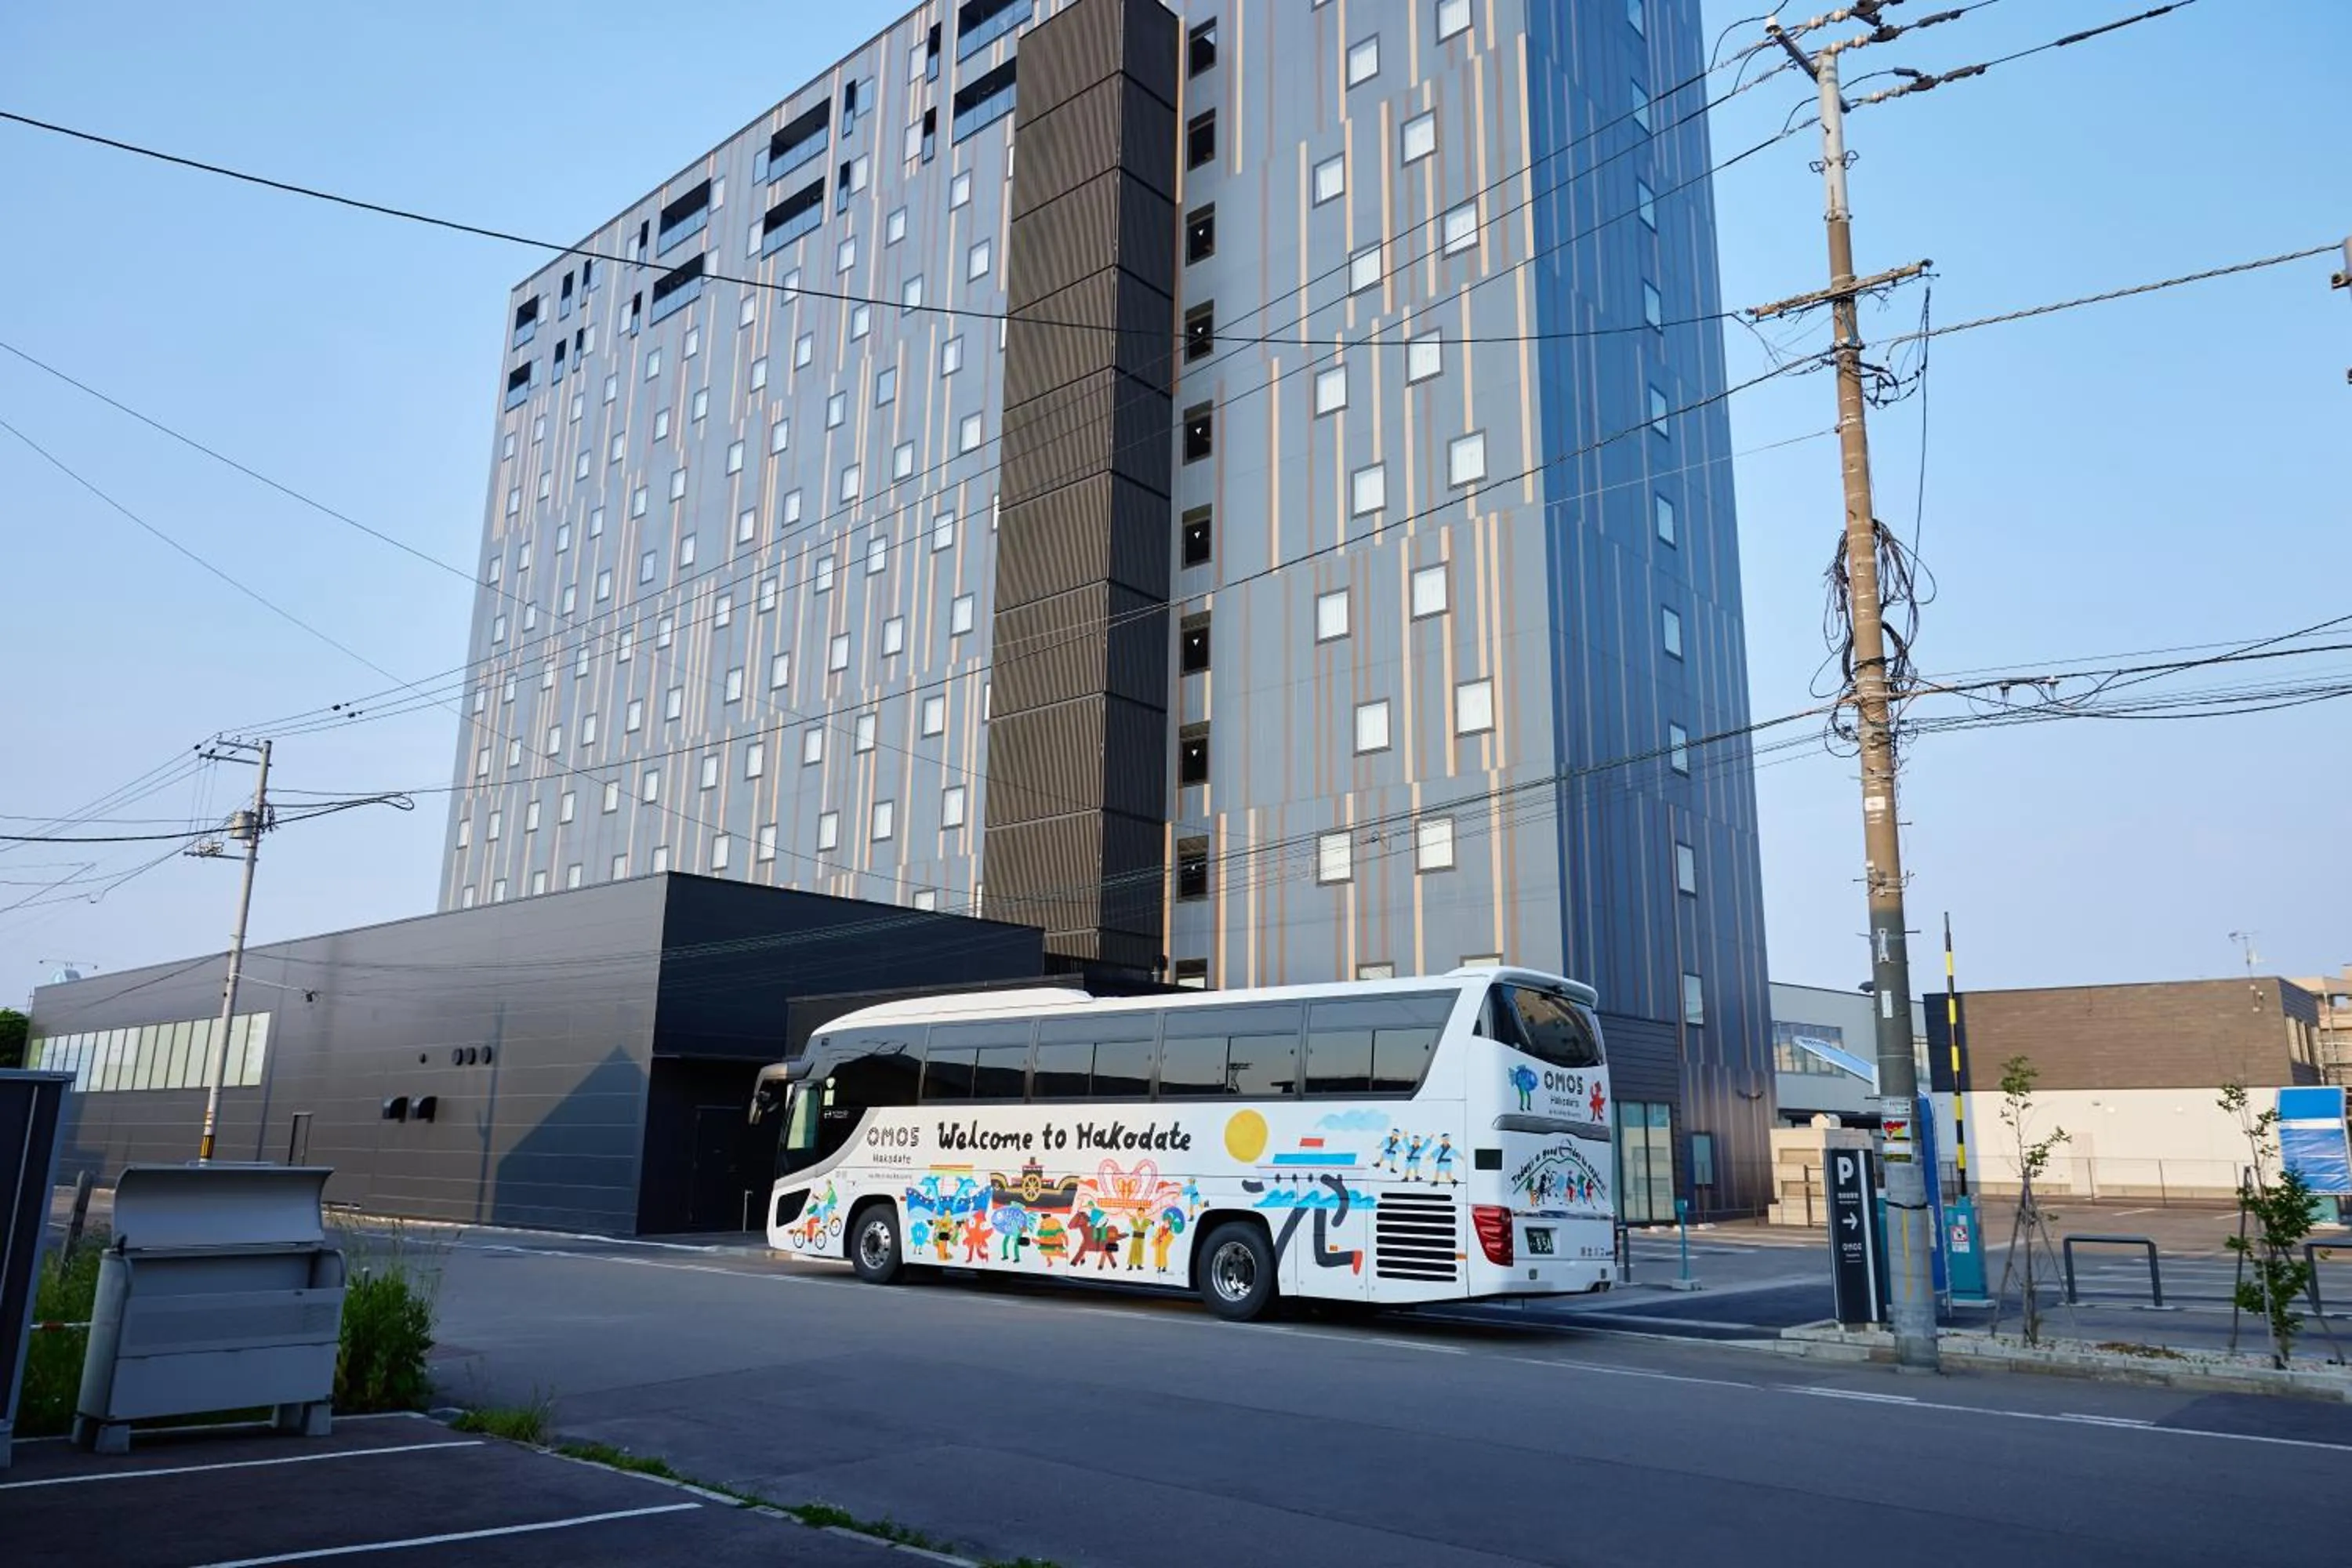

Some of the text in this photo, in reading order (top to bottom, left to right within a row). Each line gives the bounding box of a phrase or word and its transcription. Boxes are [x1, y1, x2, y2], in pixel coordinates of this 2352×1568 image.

[938, 1120, 1033, 1151] Welcome
[1042, 1123, 1067, 1150] to
[1837, 1156, 1853, 1185] P
